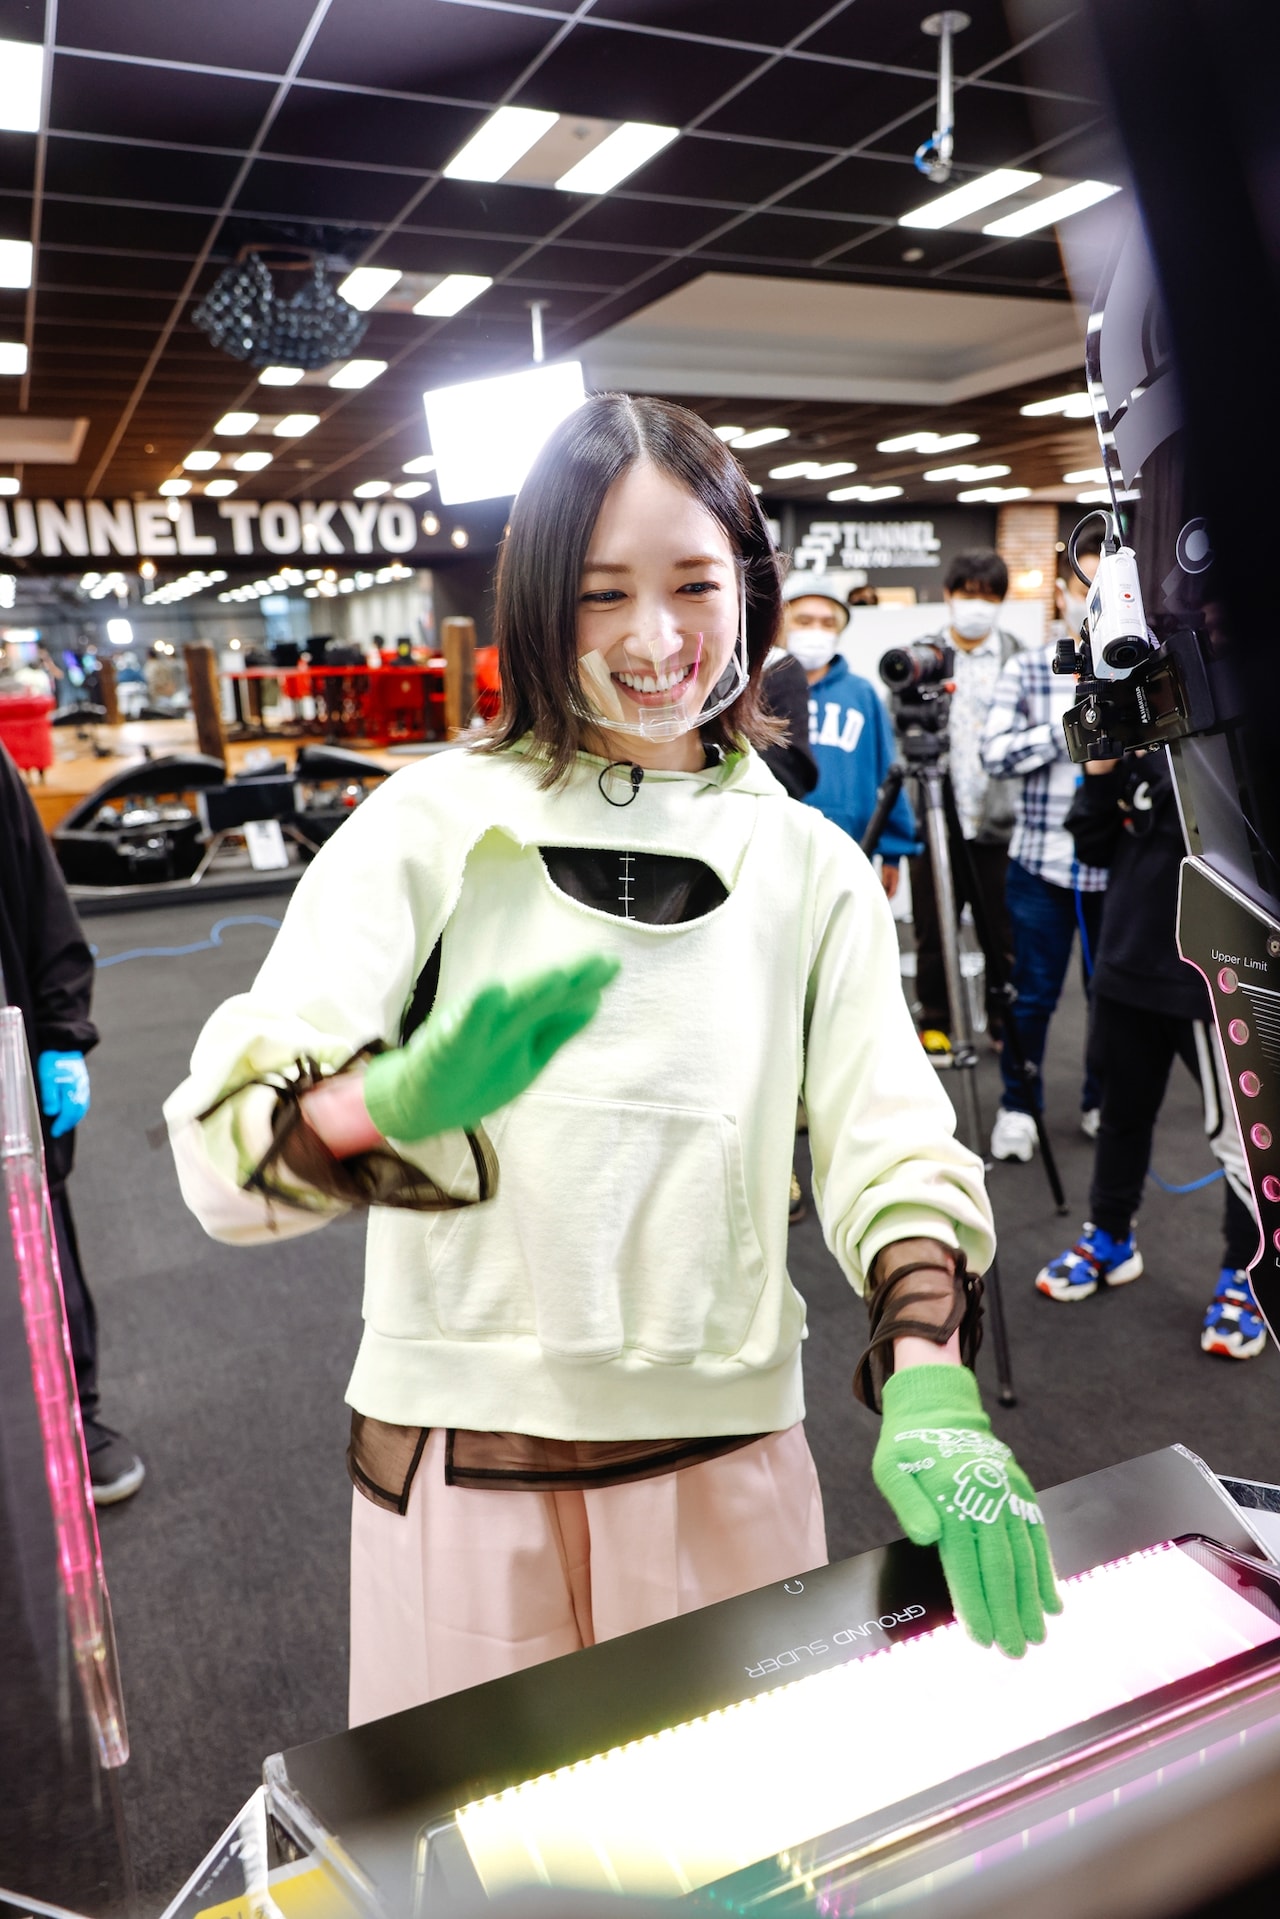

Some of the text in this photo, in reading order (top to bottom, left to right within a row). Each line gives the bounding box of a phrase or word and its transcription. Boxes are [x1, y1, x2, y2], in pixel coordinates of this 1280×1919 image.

[0, 499, 417, 556] UNNEL TOKYO
[841, 521, 941, 551] TUNNEL
[1211, 949, 1268, 972] Upper Limit
[744, 1604, 926, 1679] GROUND SLIDER
